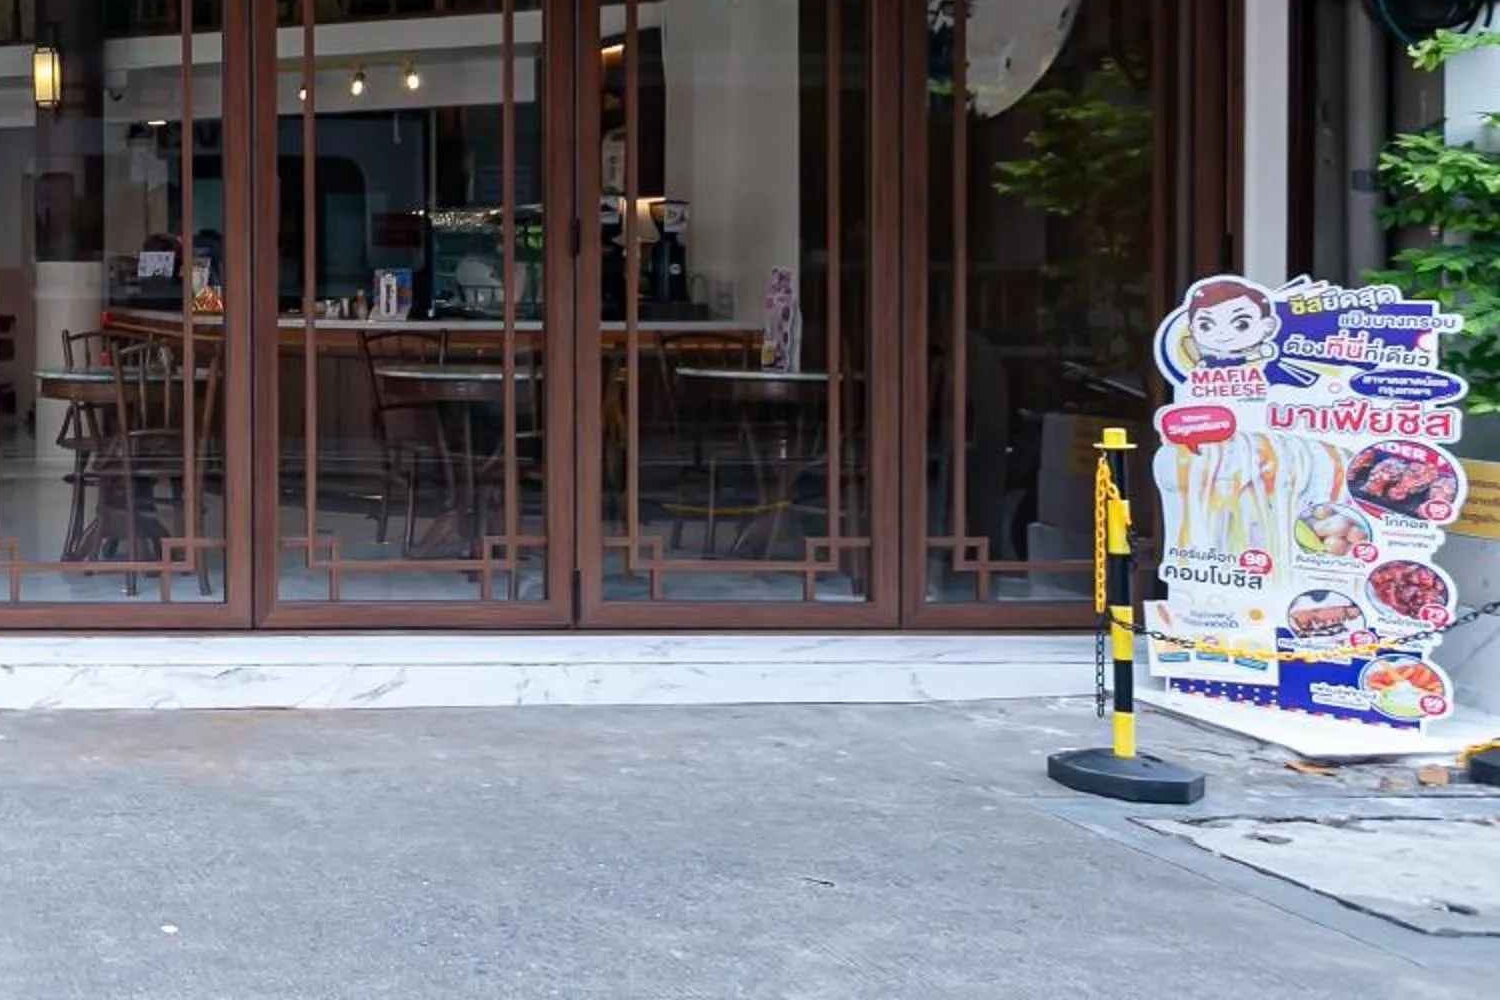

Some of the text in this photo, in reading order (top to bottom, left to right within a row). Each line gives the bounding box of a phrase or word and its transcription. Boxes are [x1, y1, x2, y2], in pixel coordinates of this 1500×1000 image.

[1191, 368, 1263, 384] MAFIA
[1191, 384, 1267, 397] CHEESE
[1270, 400, 1452, 437] มาเฟียชีส
[1164, 565, 1263, 589] คอมโบชีส
